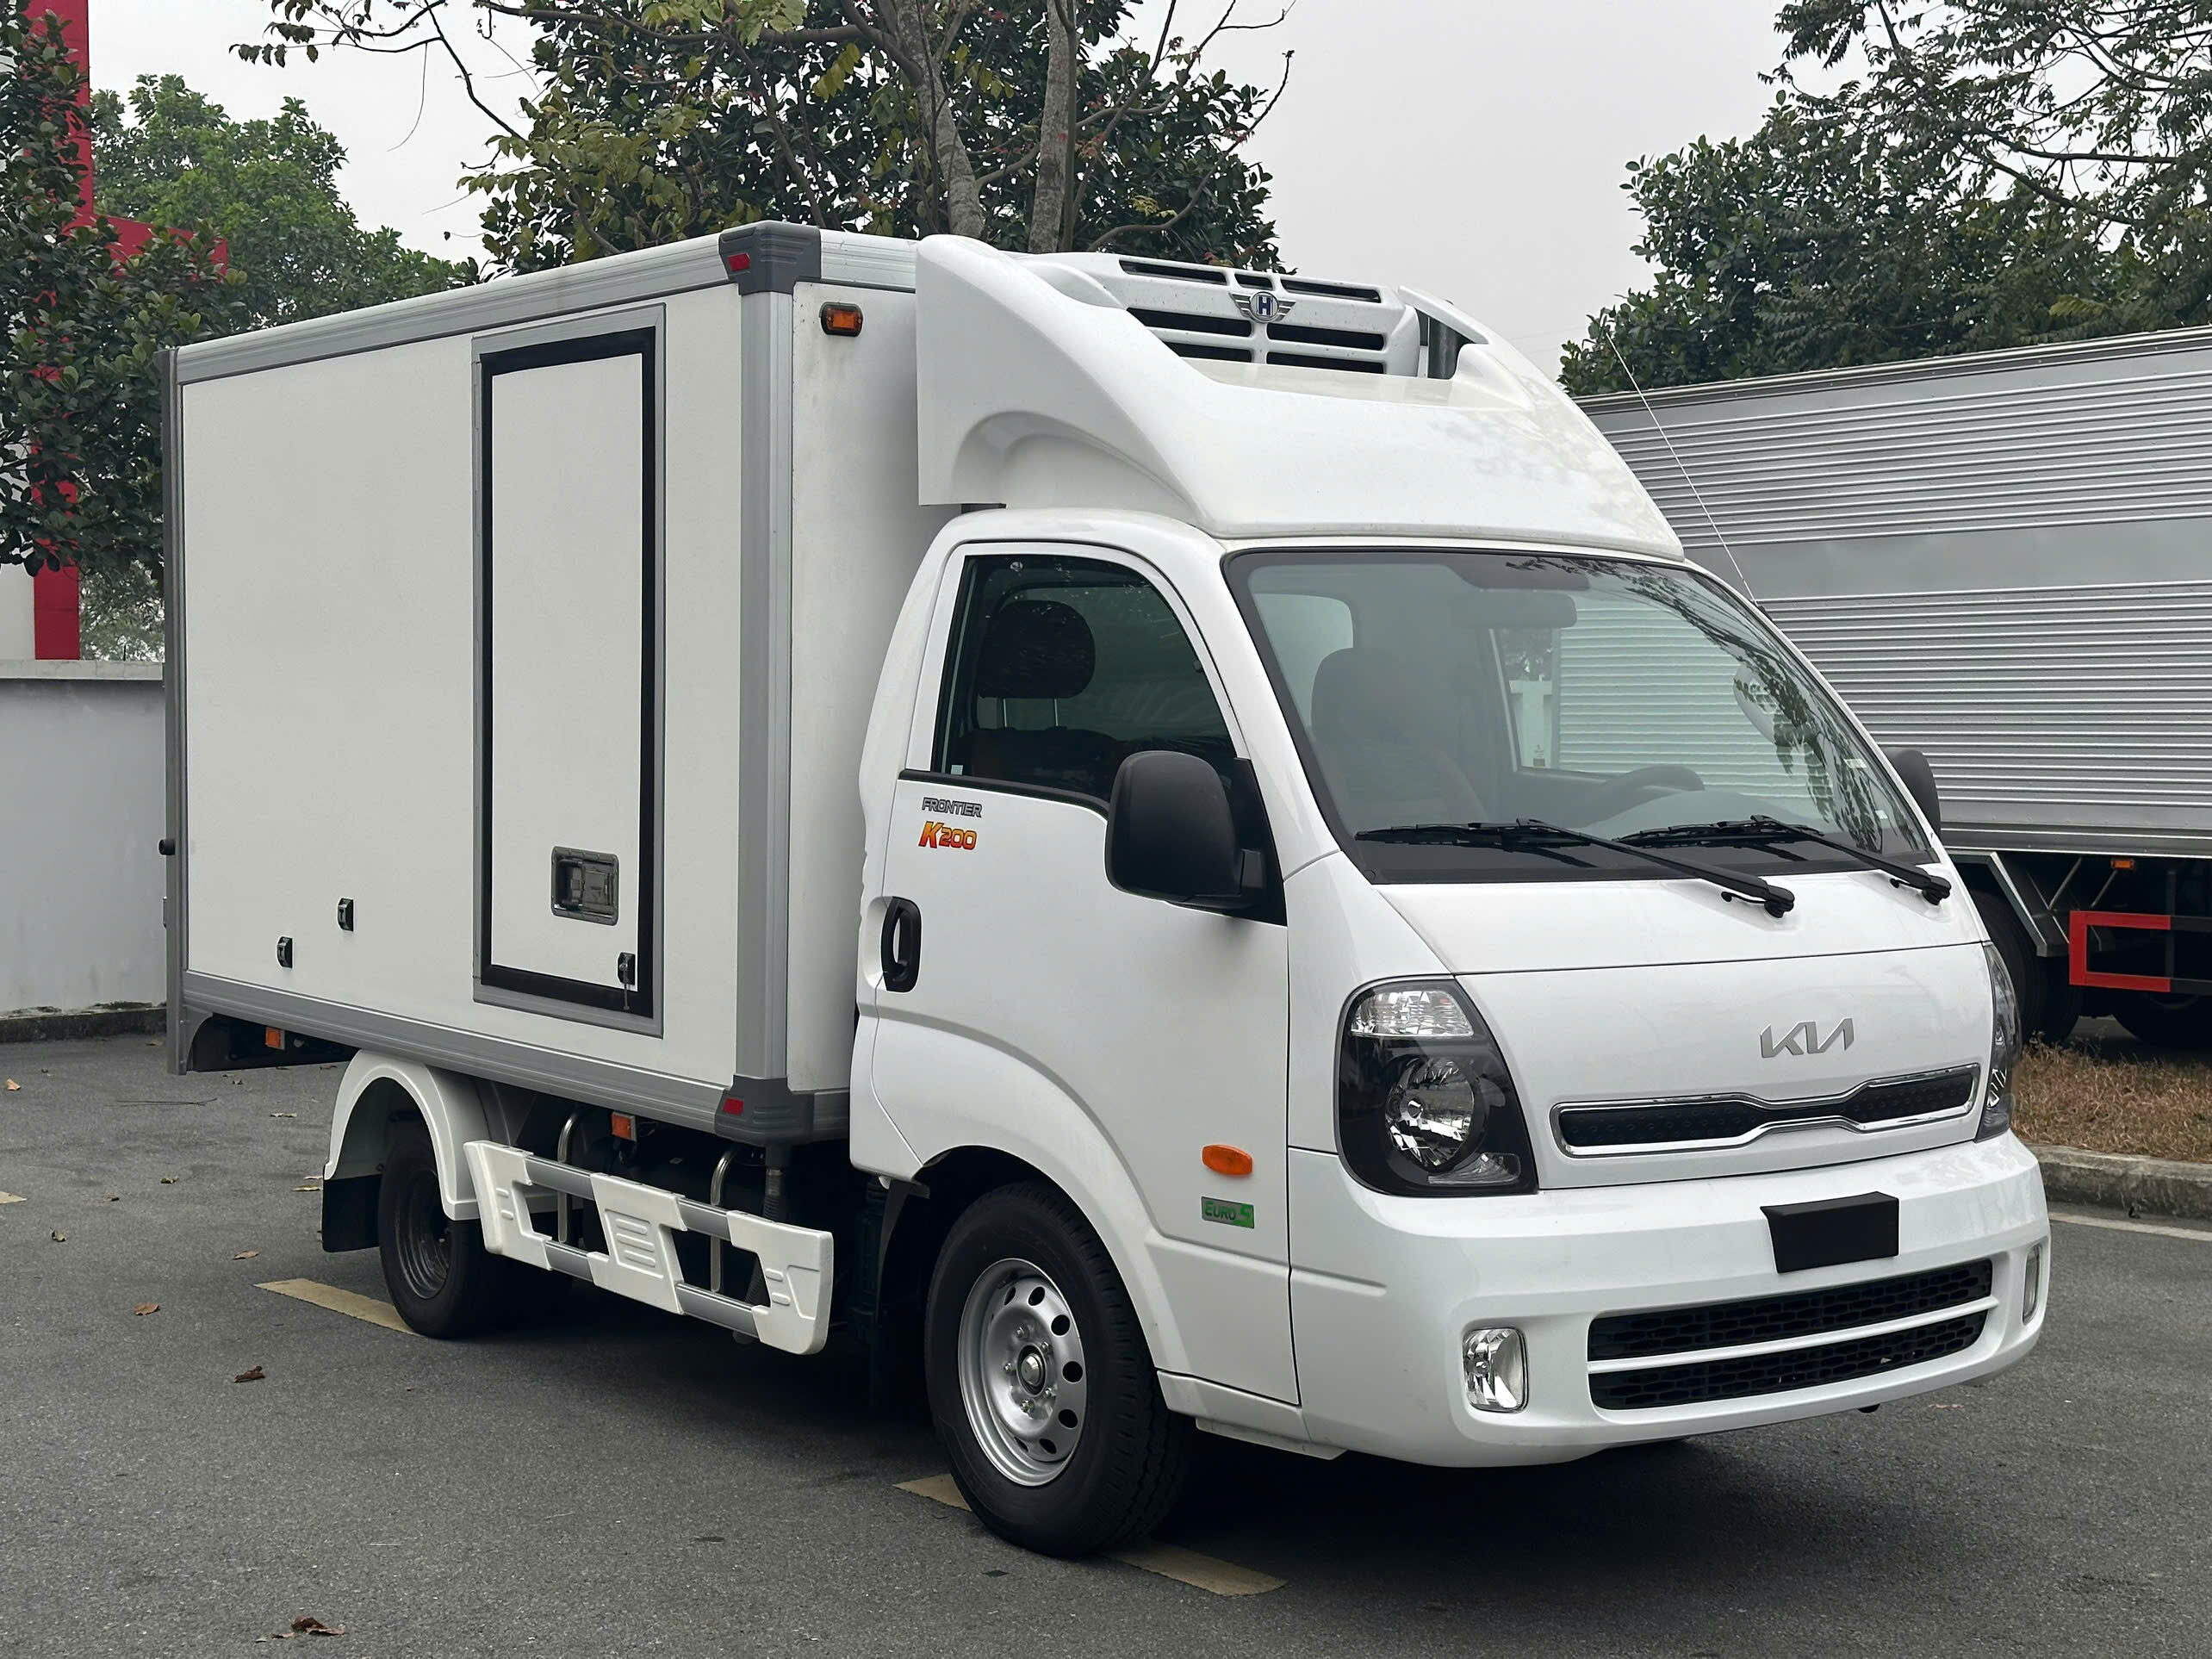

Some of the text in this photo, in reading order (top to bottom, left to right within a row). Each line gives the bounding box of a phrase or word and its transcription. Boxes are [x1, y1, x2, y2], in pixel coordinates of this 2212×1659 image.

[922, 797, 982, 817] FRONTIER
[918, 821, 977, 850] K200
[1760, 1017, 1855, 1058] KIA
[1204, 1201, 1236, 1220] EURO
